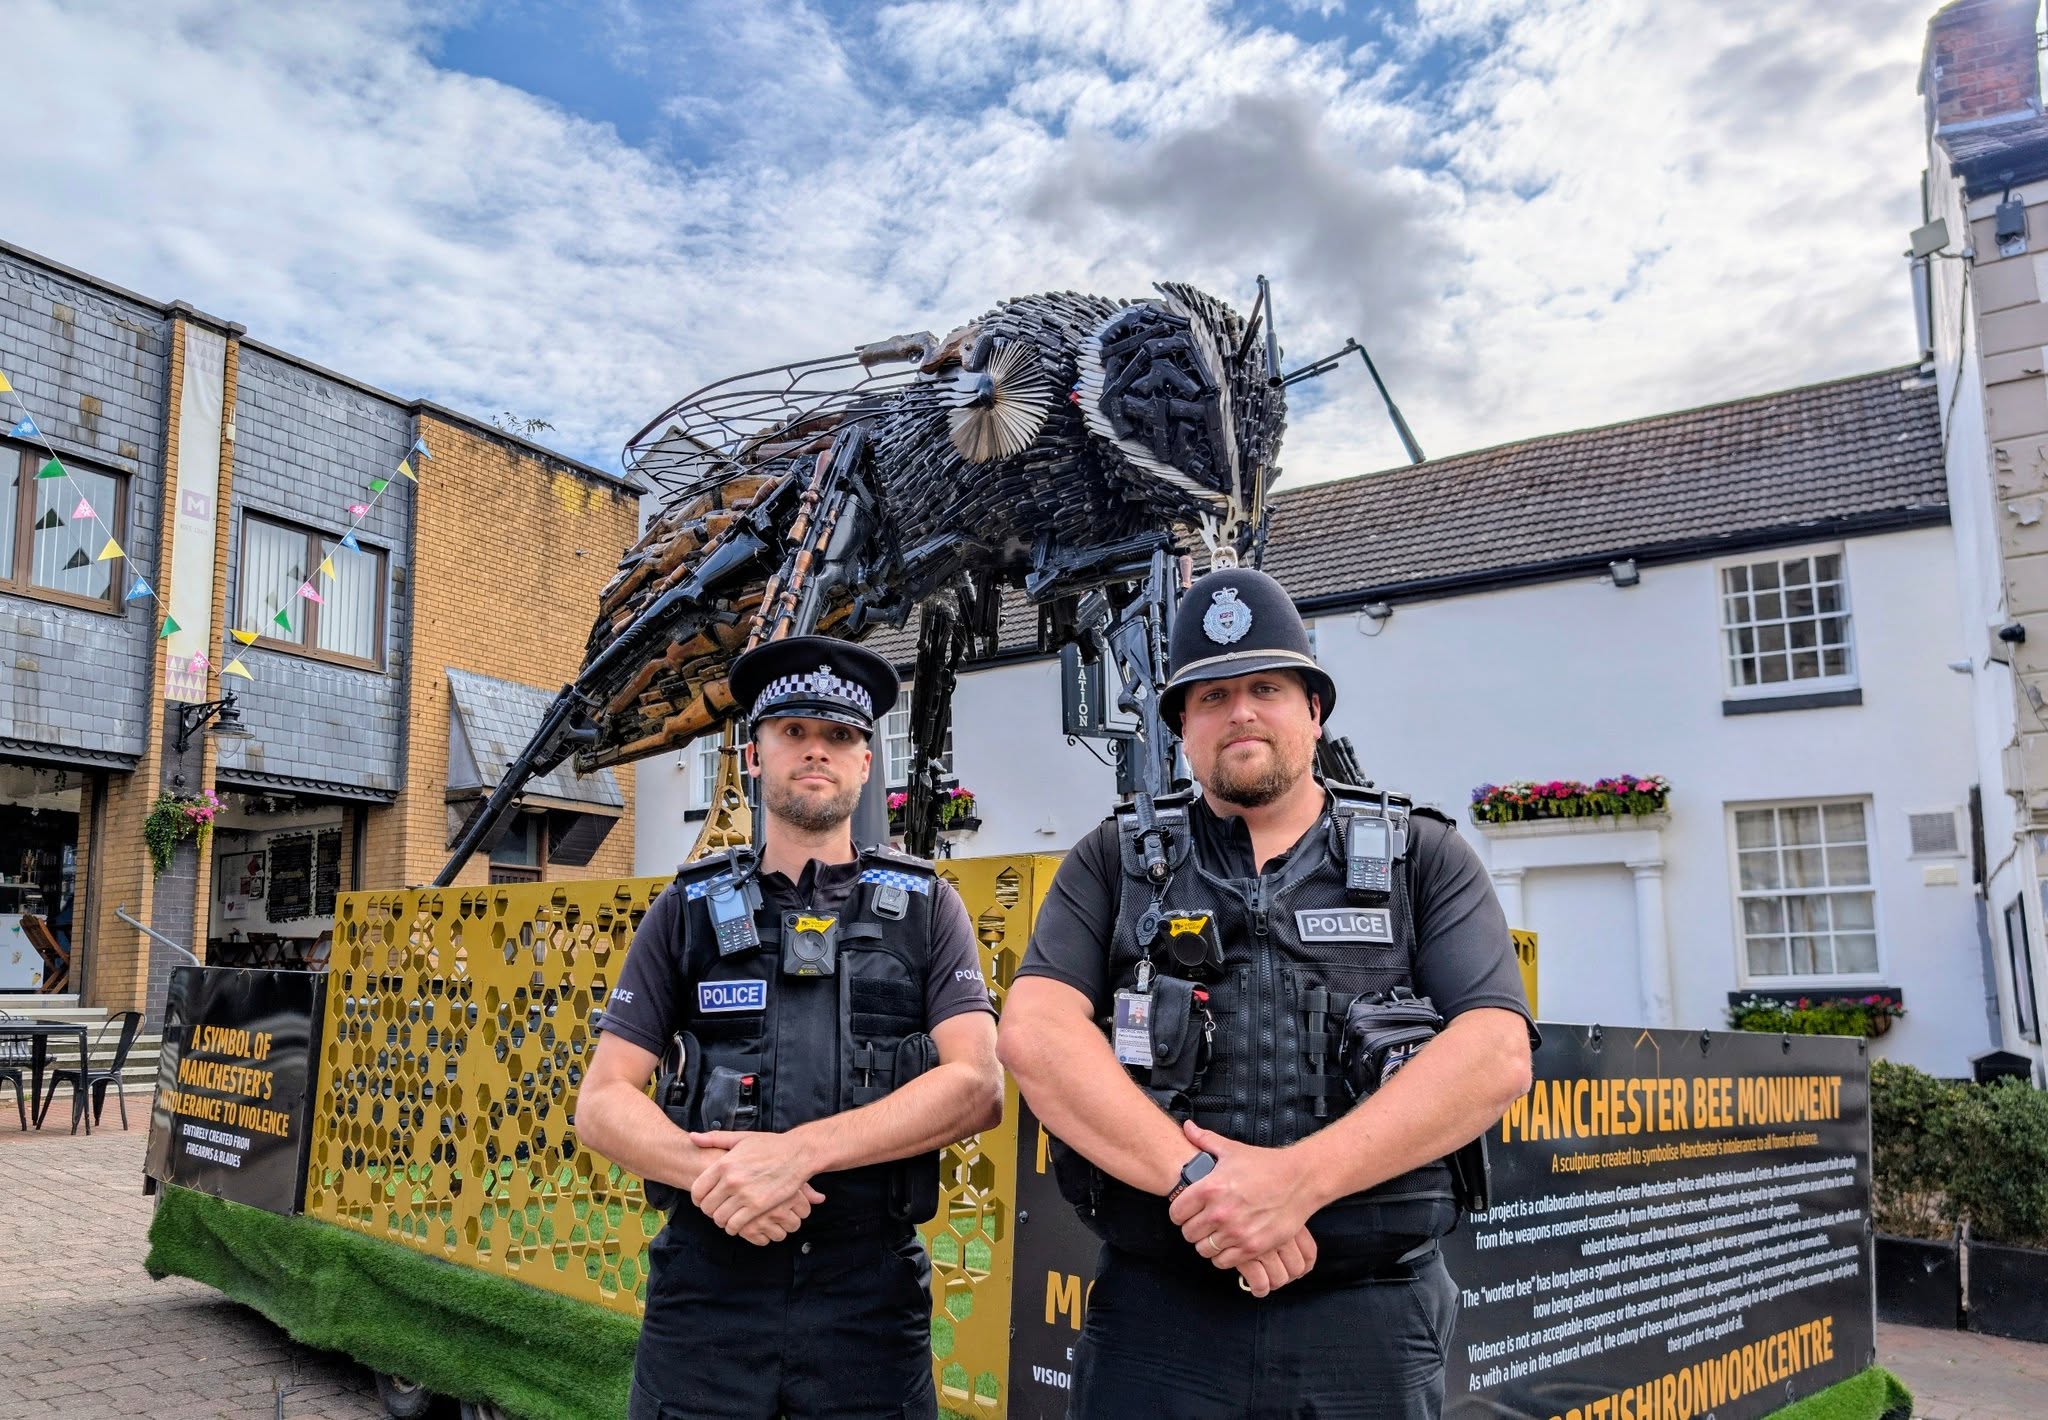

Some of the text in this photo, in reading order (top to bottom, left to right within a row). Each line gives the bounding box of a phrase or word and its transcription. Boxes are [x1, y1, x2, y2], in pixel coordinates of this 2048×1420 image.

[1077, 646, 1089, 727] LATION
[1307, 916, 1384, 933] POLICE
[611, 988, 634, 1003] LICE
[703, 985, 759, 1005] POLICE
[191, 1025, 273, 1060] A SYMBOL OF
[178, 1058, 273, 1100] MANCHESTER'S
[223, 1101, 237, 1125] TO
[238, 1105, 289, 1137] VIOLENCE
[1502, 1076, 1840, 1143] MANCHESTER BEE MONUMENT
[183, 1124, 250, 1150] ENTIRELY CREATED FROM
[185, 1142, 241, 1168] FIREARMS & BLADES
[1552, 1153, 1558, 1172] A
[1560, 1152, 1599, 1173] sculpture
[1601, 1147, 1630, 1167] created
[1632, 1147, 1640, 1164] to
[1642, 1143, 1678, 1166] symbolise
[1679, 1139, 1721, 1158] Manchester's
[1723, 1137, 1756, 1153] intolerance
[1757, 1136, 1763, 1150] to
[1772, 1133, 1788, 1148] forms
[1789, 1131, 1795, 1146] of
[1796, 1131, 1818, 1145] violence.
[1489, 1201, 1518, 1224] project
[1519, 1199, 1527, 1216] is
[1528, 1201, 1534, 1214] a
[1535, 1192, 1584, 1213] collaboration
[1585, 1190, 1615, 1206] between
[1616, 1185, 1640, 1201] Greater
[1641, 1180, 1676, 1197] Manchester
[1676, 1176, 1694, 1192] Police
[1694, 1174, 1705, 1189] and
[1706, 1173, 1715, 1188] the
[1476, 1231, 1497, 1249] from
[1499, 1227, 1513, 1246] the
[1515, 1224, 1550, 1243] weapons
[1551, 1215, 1588, 1236] recovered
[1589, 1208, 1629, 1230] successfully
[1630, 1206, 1646, 1222] from
[1647, 1200, 1686, 1219] Manchester's
[1686, 1197, 1708, 1213] streets,
[1581, 1237, 1605, 1255] violent
[1606, 1232, 1639, 1251] behaviour
[1640, 1227, 1652, 1244] and
[1652, 1226, 1666, 1241] how
[1667, 1225, 1673, 1239] to
[1674, 1222, 1698, 1237] increase
[1699, 1216, 1714, 1232] social
[1462, 1289, 1479, 1308] The
[1536, 1274, 1550, 1291] has
[1552, 1271, 1568, 1289] long
[1570, 1267, 1588, 1284] been
[1589, 1266, 1593, 1279] a
[1595, 1257, 1619, 1280] symbol
[1621, 1255, 1628, 1272] of
[1630, 1248, 1670, 1269] Manchester's
[1670, 1243, 1692, 1263] people,
[1693, 1238, 1711, 1258] people
[1533, 1302, 1549, 1318] now
[1552, 1295, 1572, 1314] being
[1574, 1287, 1594, 1308] asked
[1596, 1287, 1603, 1302] to
[1605, 1281, 1621, 1300] work
[1623, 1280, 1638, 1295] even
[1639, 1273, 1660, 1291] harder
[1661, 1272, 1668, 1286] to
[1668, 1266, 1685, 1283] make
[1685, 1263, 1708, 1279] violence
[1468, 1340, 1505, 1362] Violence
[1507, 1335, 1514, 1353] is
[1515, 1331, 1529, 1350] not
[1531, 1330, 1542, 1346] an
[1543, 1317, 1582, 1342] acceptable
[1583, 1310, 1614, 1330] response
[1616, 1308, 1623, 1321] or
[1625, 1302, 1636, 1319] the
[1637, 1298, 1660, 1315] answer
[1661, 1295, 1667, 1309] to
[1668, 1295, 1673, 1307] a
[1673, 1287, 1697, 1308] problem
[1698, 1286, 1704, 1298] or
[1705, 1275, 1742, 1296] disagreement,
[1667, 1335, 1681, 1352] their
[1682, 1331, 1695, 1350] part
[1695, 1327, 1704, 1343] for
[1704, 1324, 1714, 1340] the
[1469, 1372, 1480, 1391] As
[1482, 1365, 1501, 1387] with
[1503, 1367, 1508, 1381] a
[1510, 1360, 1527, 1379] hive
[1529, 1356, 1536, 1373] in
[1538, 1351, 1551, 1370] the
[1553, 1341, 1579, 1365] natural
[1581, 1335, 1602, 1356] world,
[1604, 1332, 1615, 1349] the
[1616, 1327, 1638, 1345] colony
[1639, 1321, 1646, 1338] of
[1647, 1320, 1662, 1336] bees
[1663, 1312, 1678, 1331] work
[1679, 1302, 1717, 1325] harmoniously
